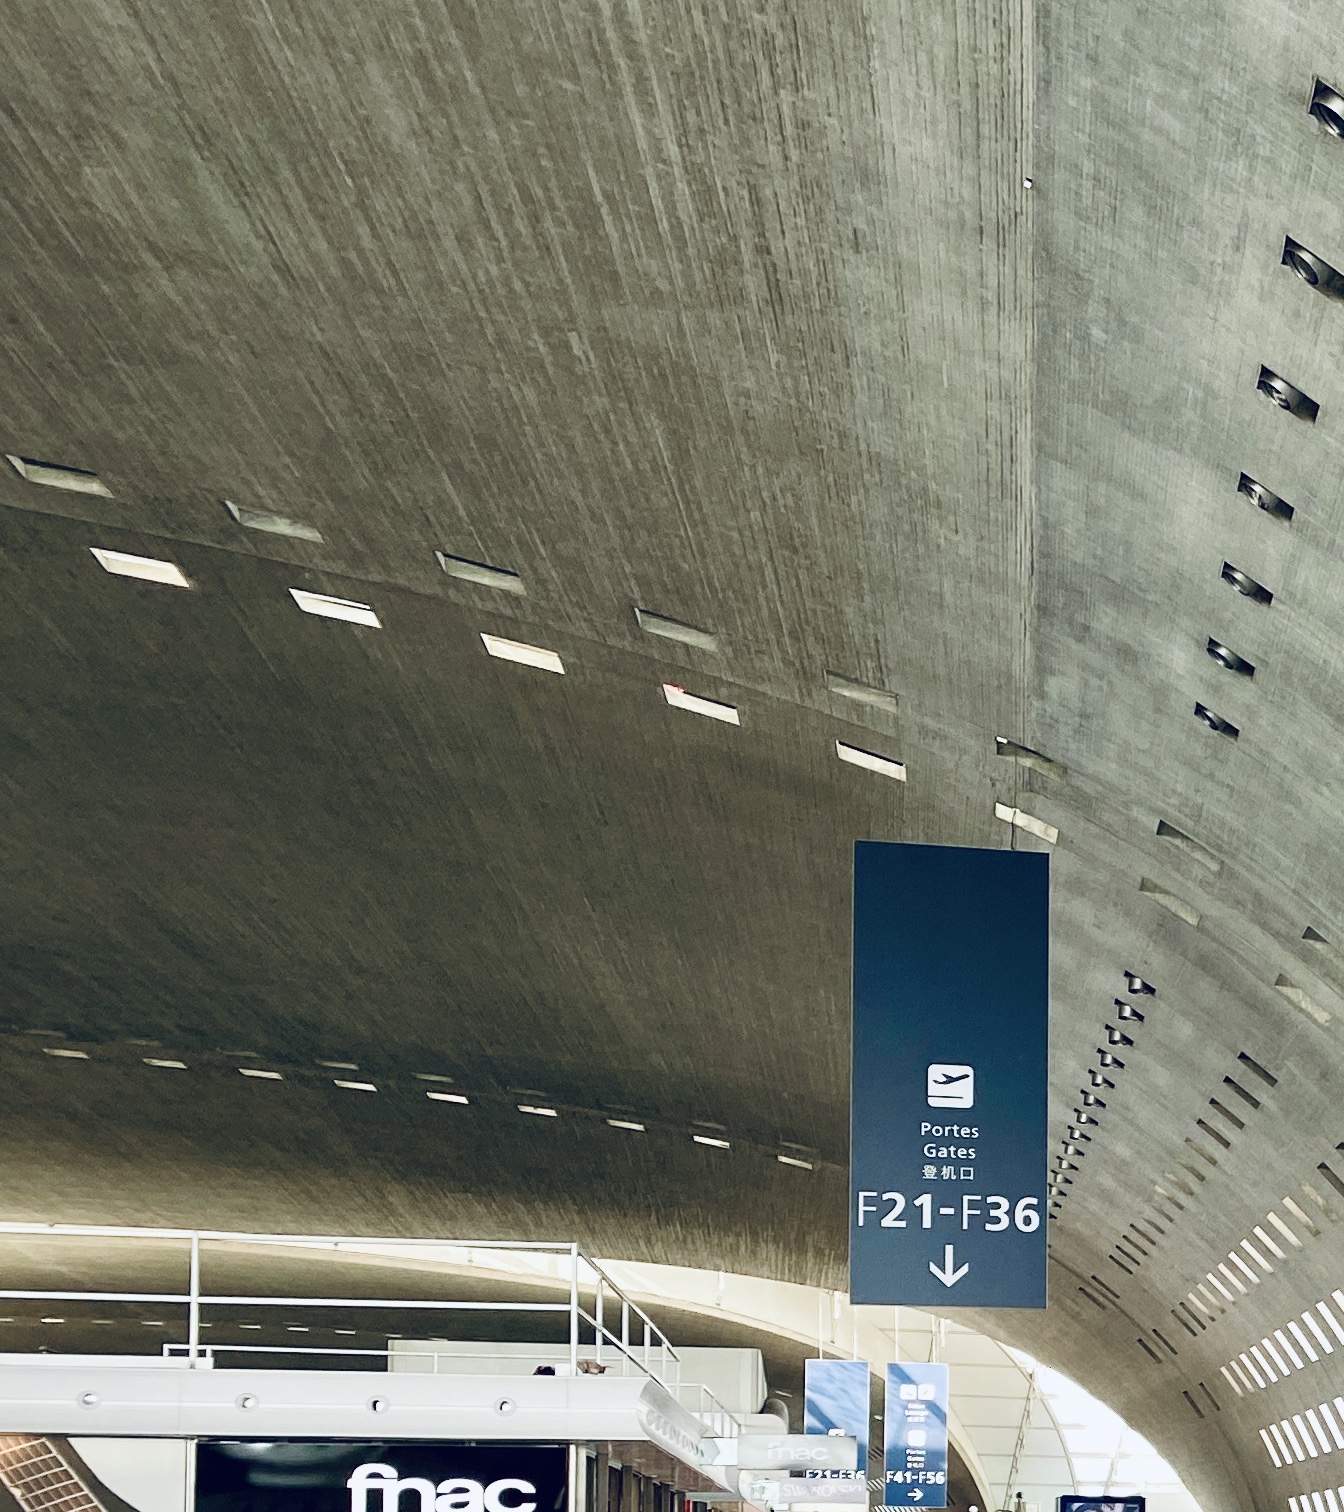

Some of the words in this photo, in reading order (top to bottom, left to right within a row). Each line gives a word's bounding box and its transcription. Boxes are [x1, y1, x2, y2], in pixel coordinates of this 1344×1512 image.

[920, 1121, 980, 1139] Portes
[922, 1142, 977, 1160] Gates
[921, 1164, 975, 1181] 登机口
[856, 1190, 1041, 1233] F21-F36
[766, 1442, 829, 1461] fnac
[885, 1470, 946, 1485] F41-F56
